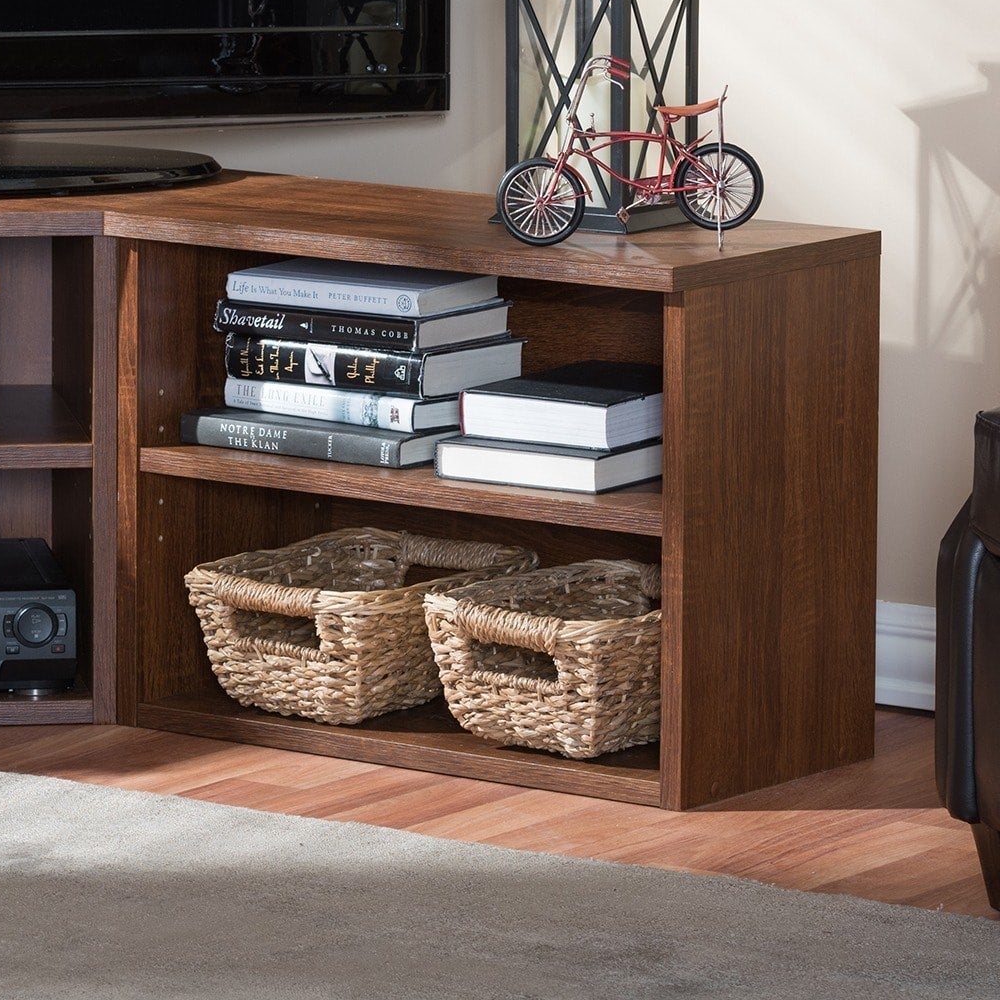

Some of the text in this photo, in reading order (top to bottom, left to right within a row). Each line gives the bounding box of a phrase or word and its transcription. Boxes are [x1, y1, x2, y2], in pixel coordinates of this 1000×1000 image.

[232, 280, 249, 295] Life
[250, 285, 257, 293] Is
[258, 285, 278, 295] What
[279, 287, 292, 297] You
[293, 288, 311, 299] Make
[328, 292, 388, 305] PETER BUFFETT
[222, 307, 286, 330] Shavetail
[330, 324, 409, 340] THOMAS COBB
[236, 384, 257, 398] THE
[219, 423, 288, 440] NOTRE DAME
[227, 436, 279, 450] THE KLAN
